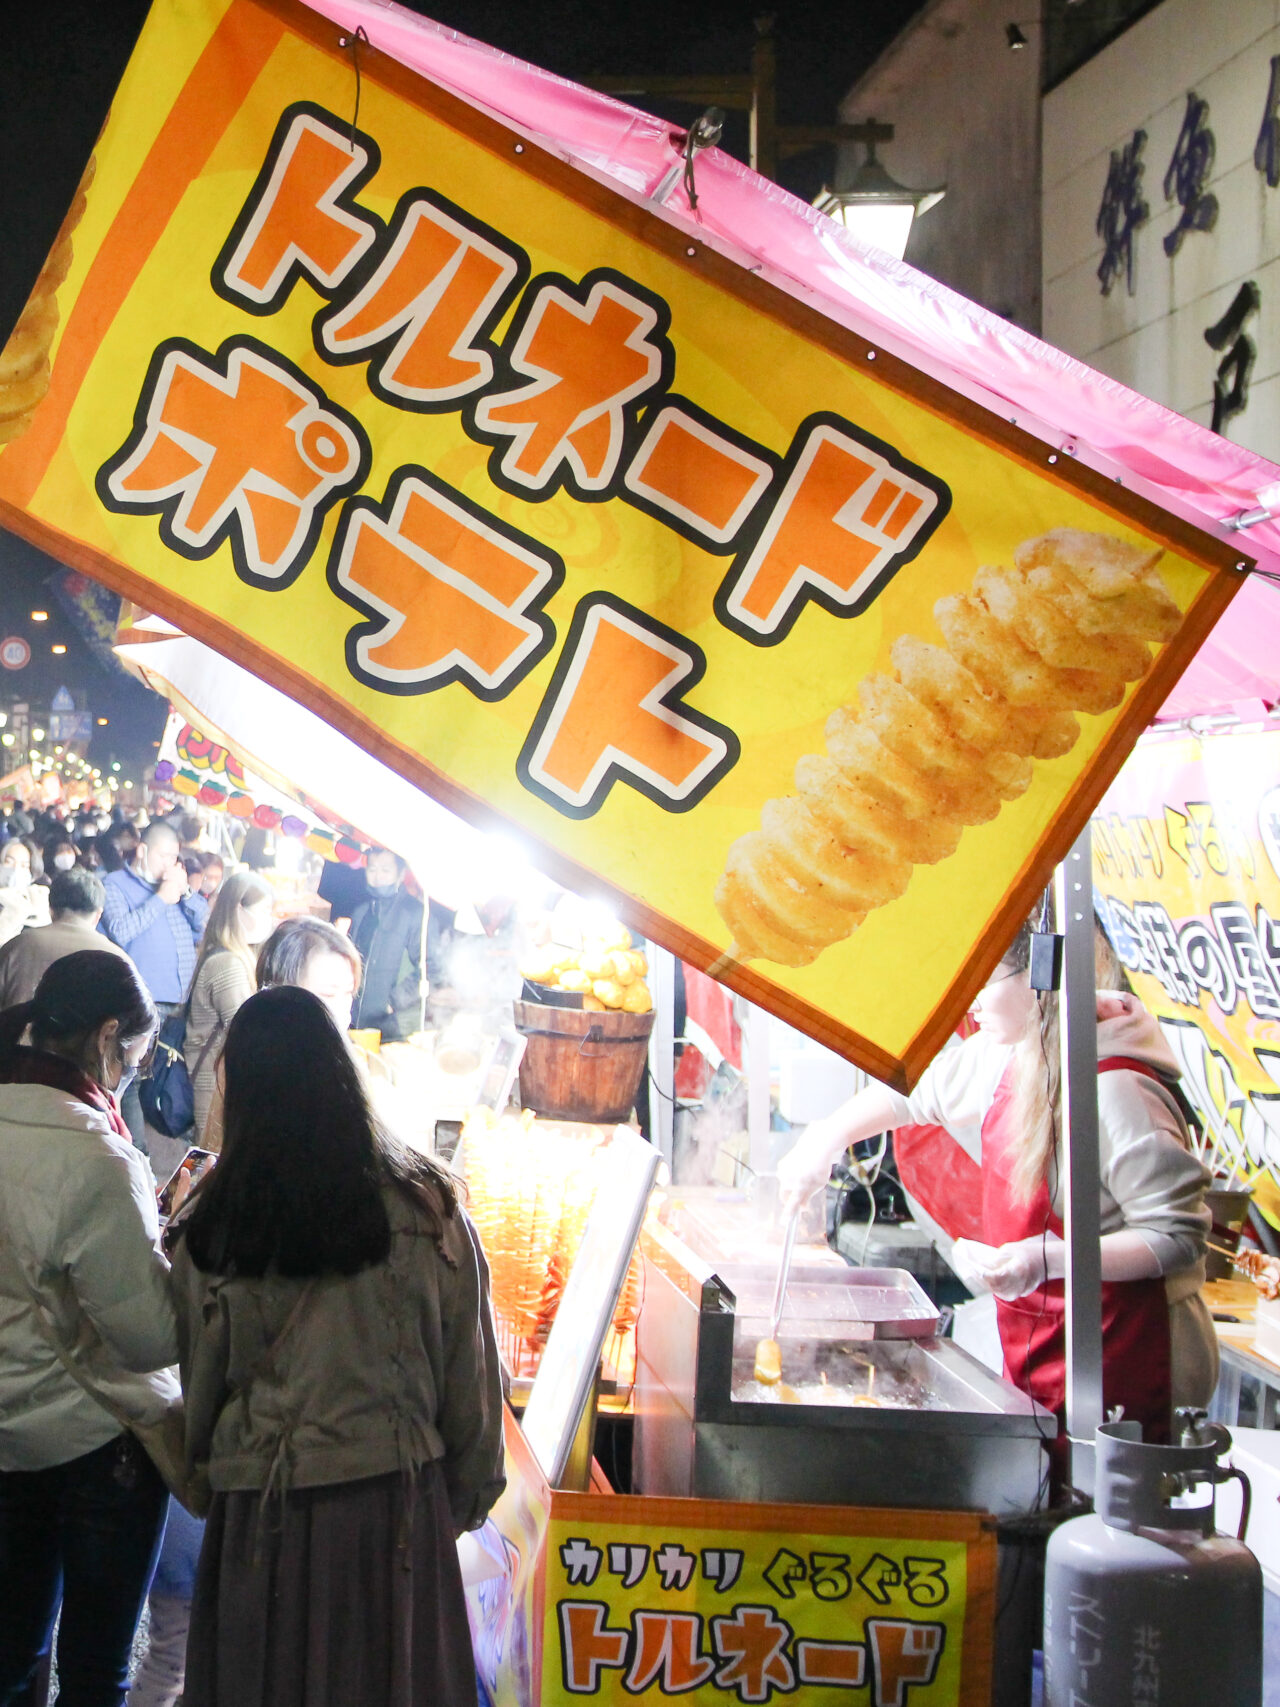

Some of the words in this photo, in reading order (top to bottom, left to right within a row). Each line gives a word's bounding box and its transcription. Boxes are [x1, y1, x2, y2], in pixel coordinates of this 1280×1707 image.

[210, 101, 953, 647] トルネード
[96, 334, 741, 820] ポテト
[557, 1600, 946, 1707] トルネード
[559, 1537, 744, 1594] カリカリ
[762, 1547, 949, 1607] ぐるぐる
